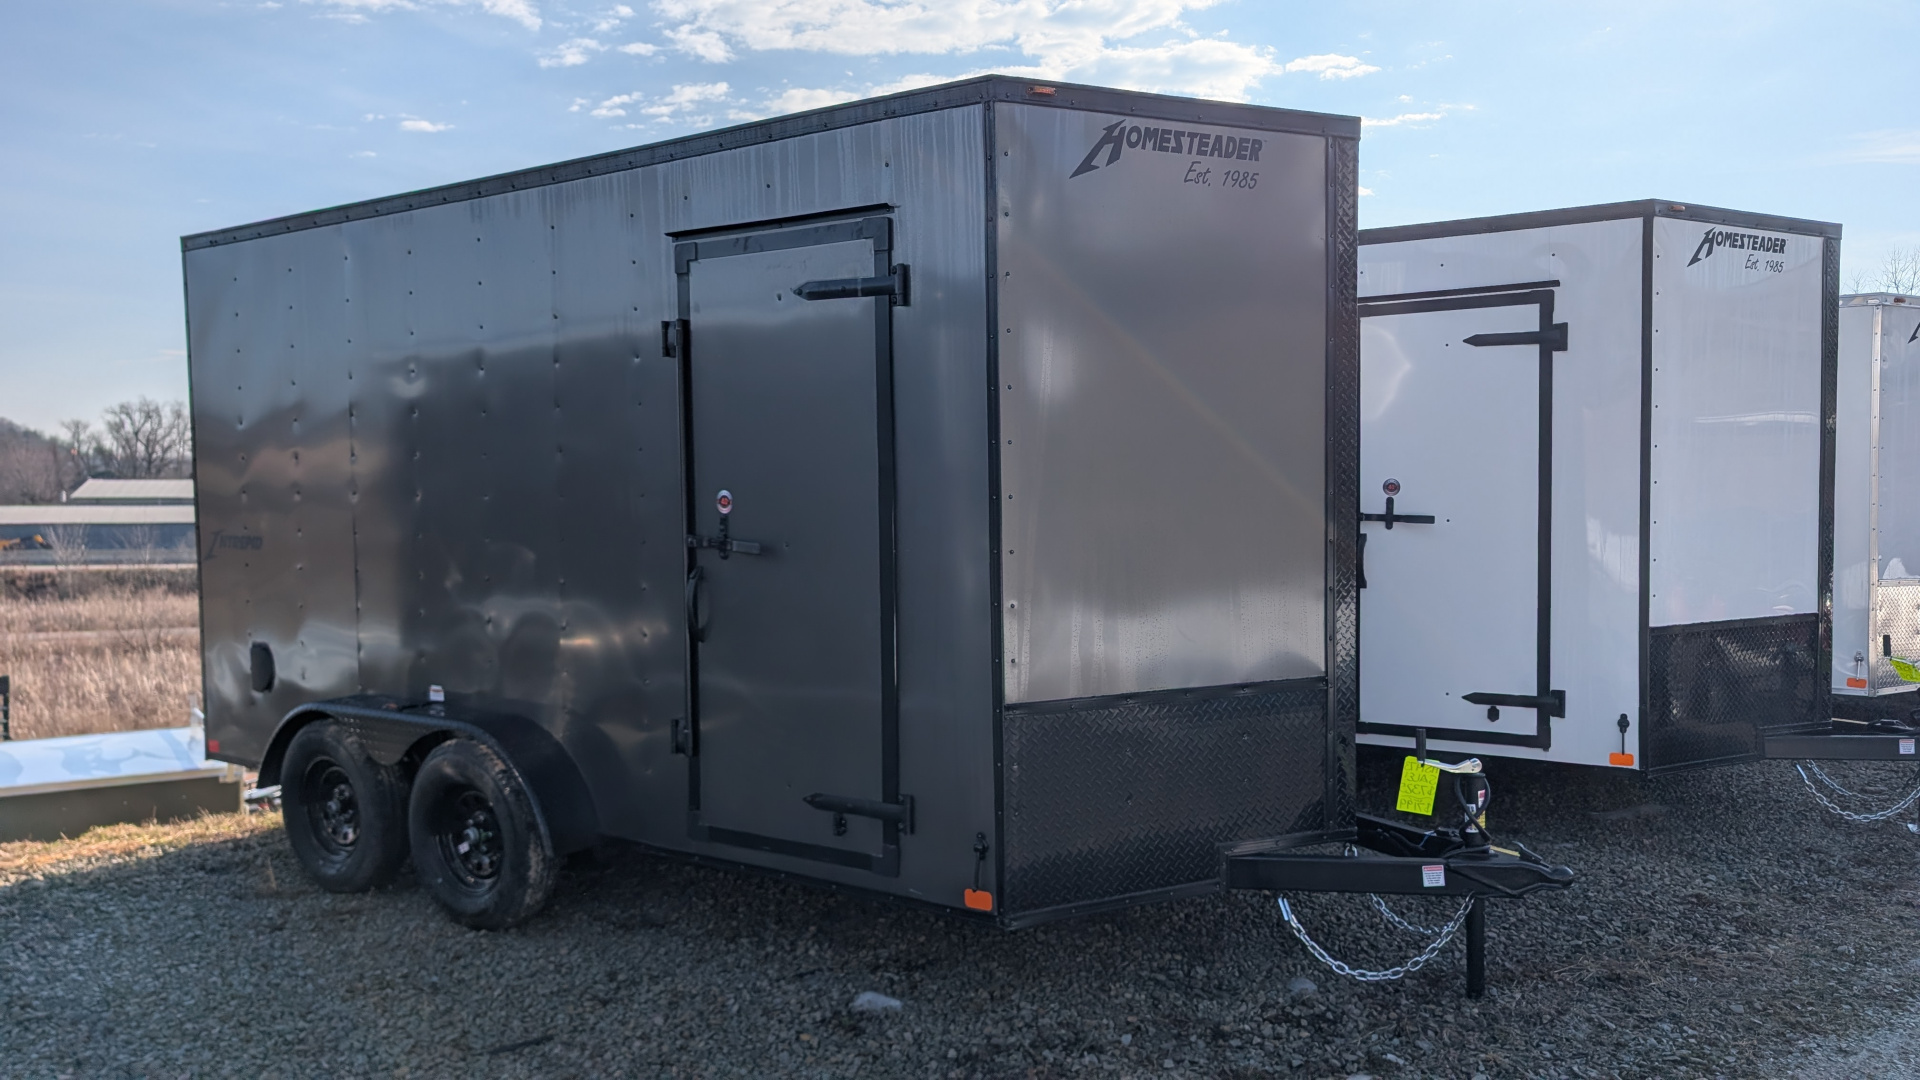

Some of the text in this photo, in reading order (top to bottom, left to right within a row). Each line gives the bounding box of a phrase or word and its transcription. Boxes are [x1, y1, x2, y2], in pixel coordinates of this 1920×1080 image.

[1069, 119, 1263, 179] HOMESTEADER
[1183, 161, 1260, 190] Est. 1985
[1686, 226, 1787, 268] HOMESTEADER
[1744, 253, 1785, 273] Est. 1985
